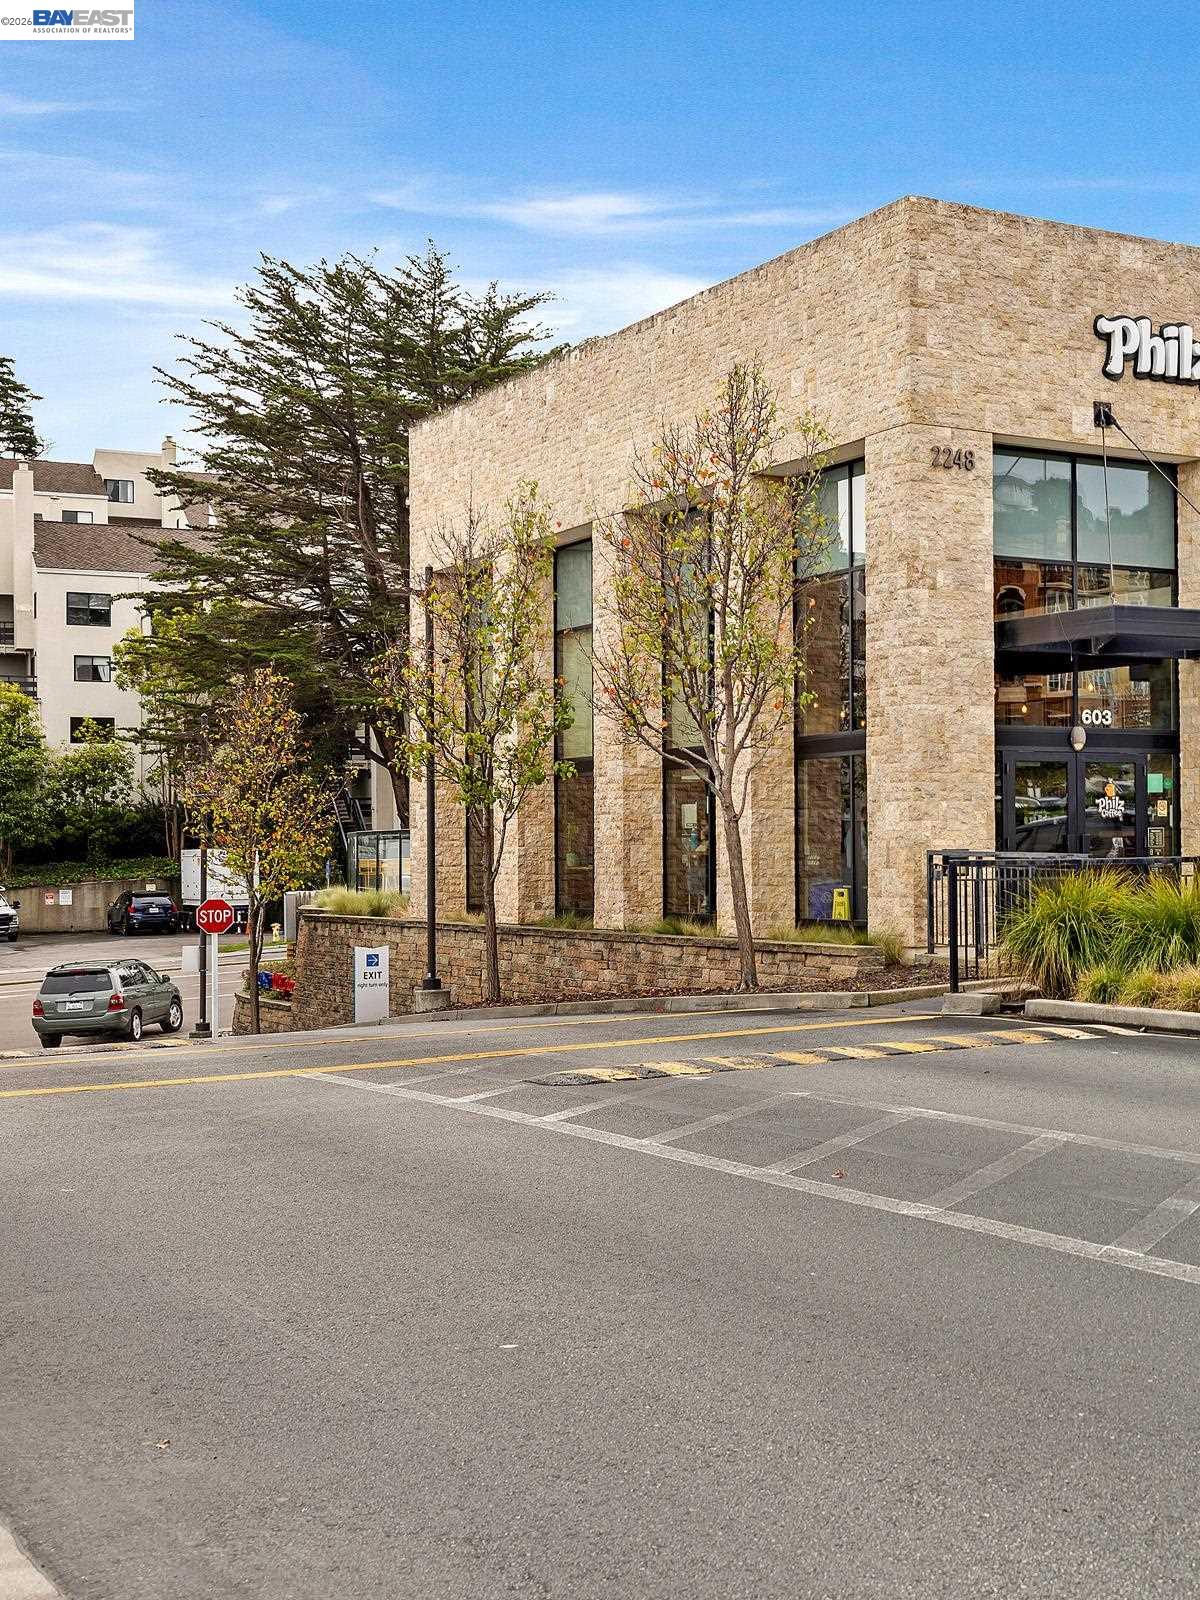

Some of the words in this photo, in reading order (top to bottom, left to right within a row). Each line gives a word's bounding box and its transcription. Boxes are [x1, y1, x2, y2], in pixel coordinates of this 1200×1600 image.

[930, 446, 975, 471] 2248
[1081, 709, 1113, 725] 603
[1095, 796, 1125, 814] Philz
[200, 909, 231, 923] STOP
[363, 971, 383, 980] EXIT
